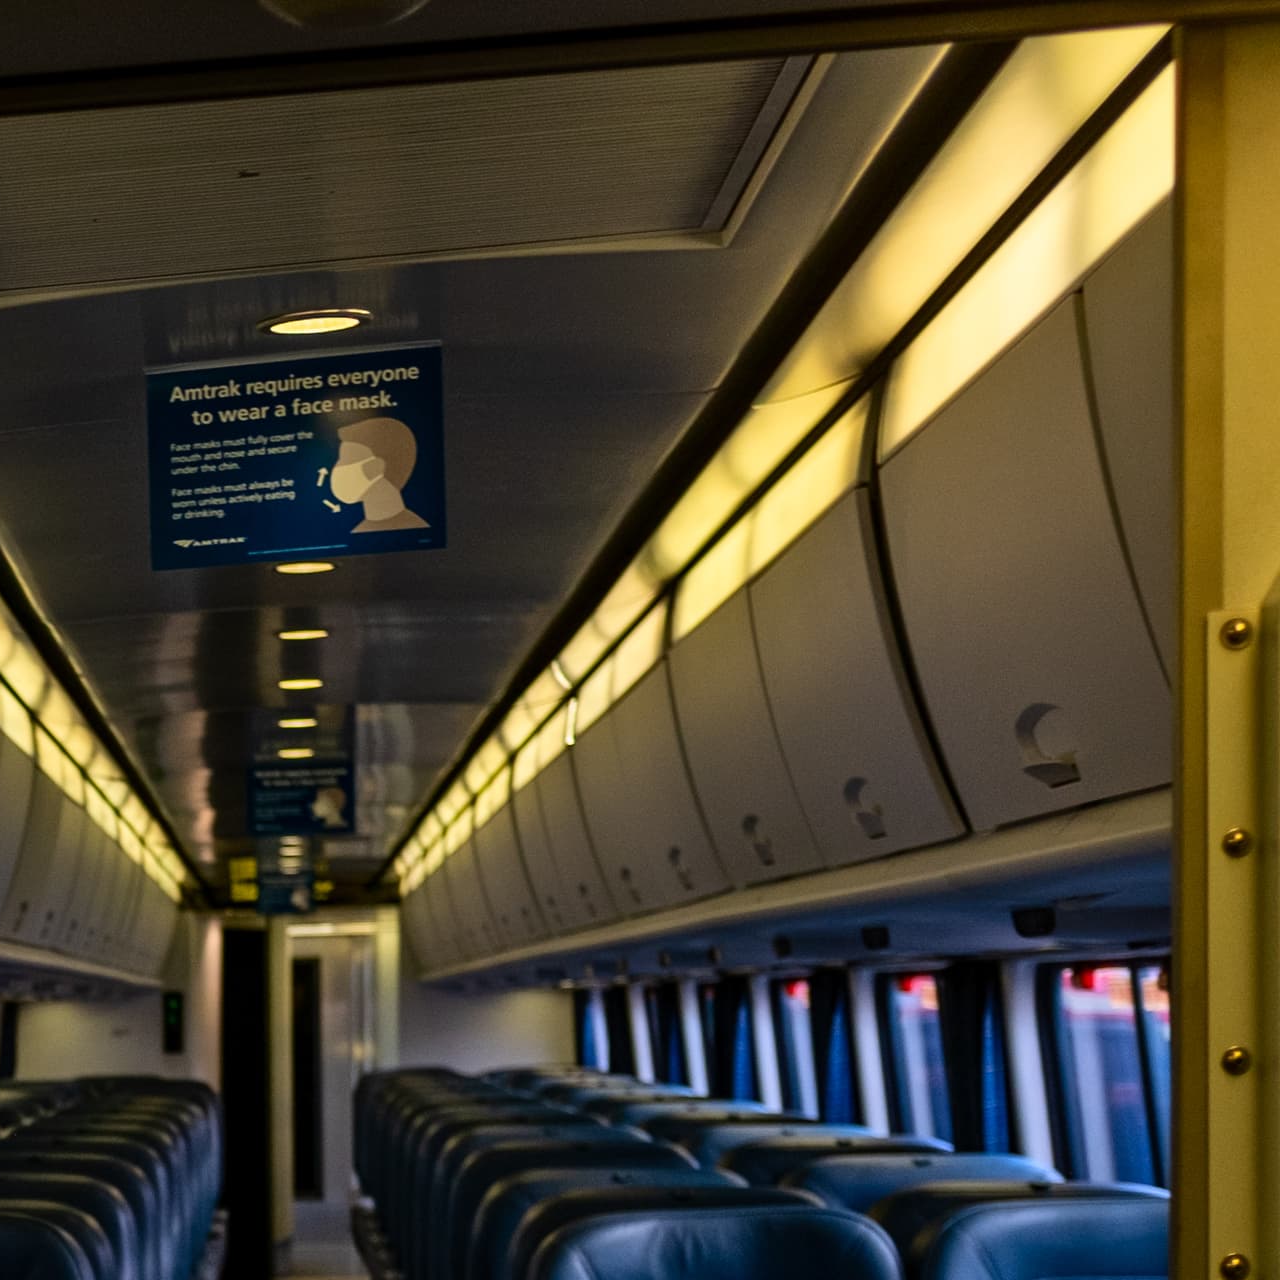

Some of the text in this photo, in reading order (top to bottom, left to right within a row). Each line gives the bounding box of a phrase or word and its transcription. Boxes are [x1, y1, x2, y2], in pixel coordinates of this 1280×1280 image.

[169, 366, 420, 403] Amtrak requires everyone
[192, 390, 398, 426] to wear a face mask.
[170, 431, 313, 452] Face masks must fully cover the
[170, 445, 297, 463] mouth and nose and secure
[170, 466, 198, 475] under
[200, 464, 216, 472] the
[171, 478, 295, 497] Face masks must always be
[171, 490, 296, 508] worn unless actively eating
[172, 512, 182, 520] or
[193, 537, 246, 547] AMTRAK
